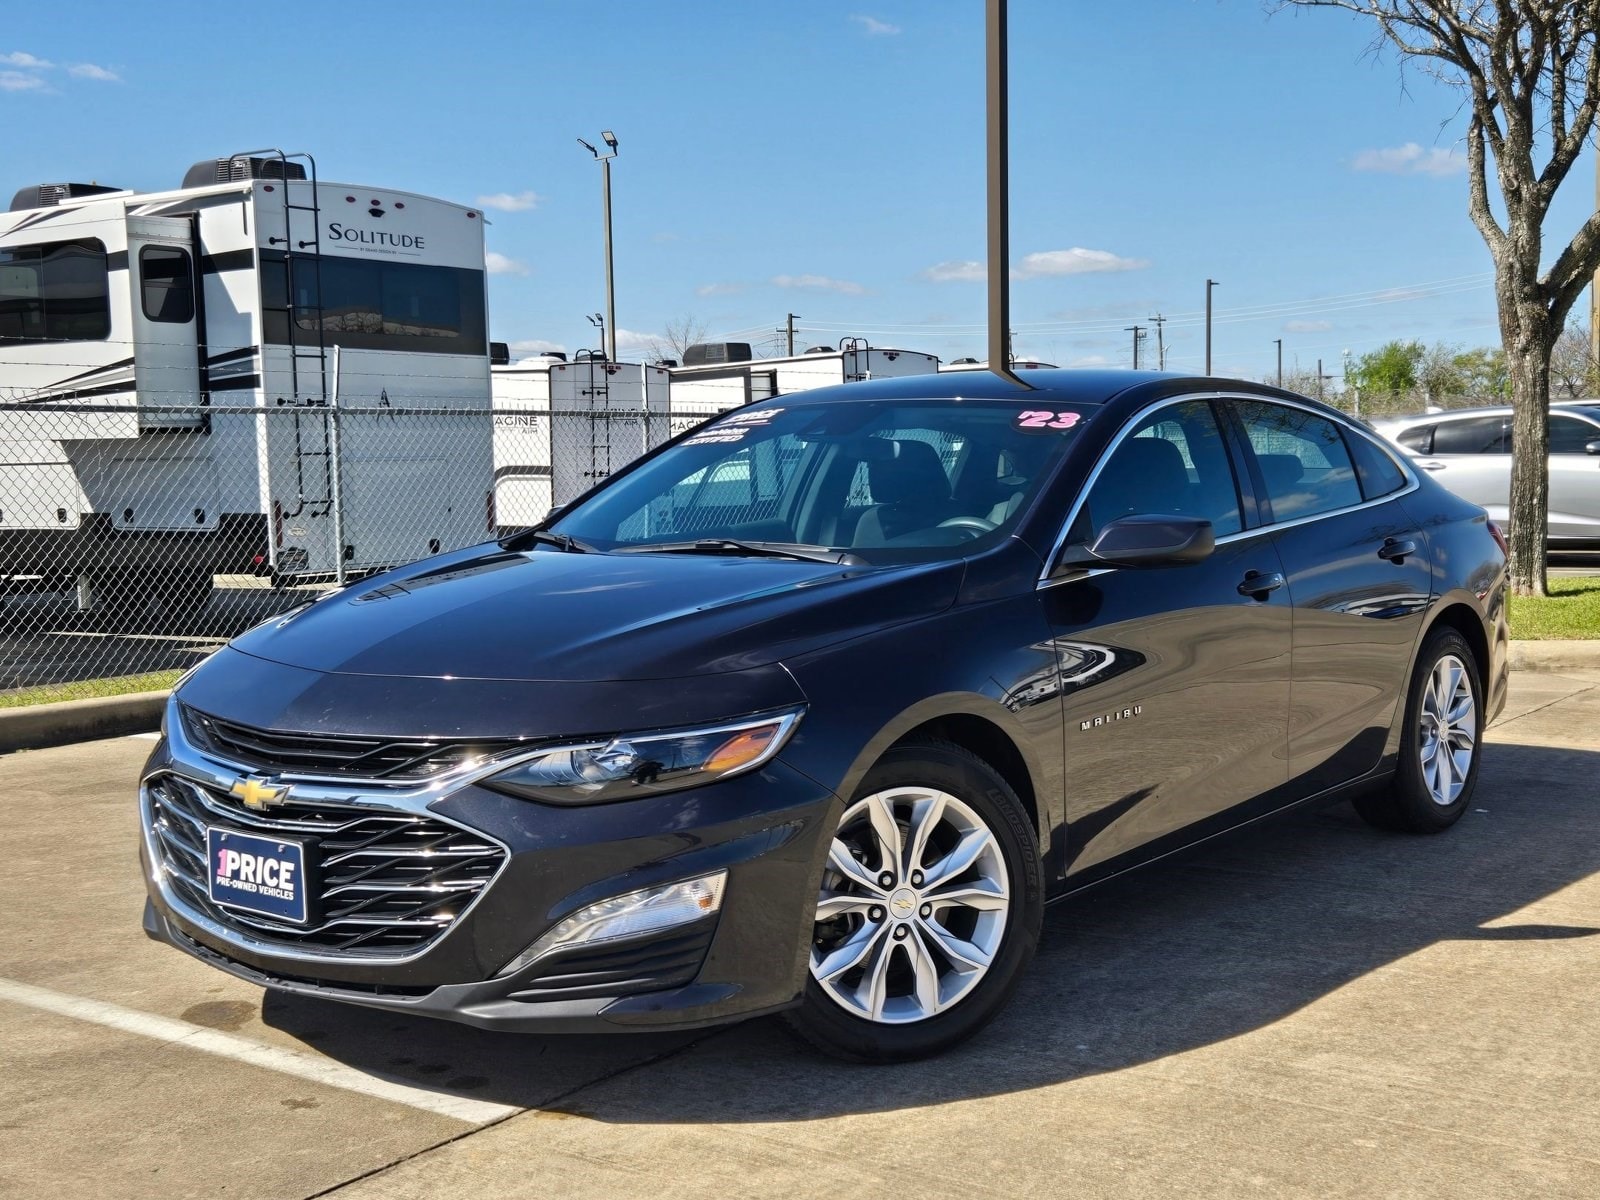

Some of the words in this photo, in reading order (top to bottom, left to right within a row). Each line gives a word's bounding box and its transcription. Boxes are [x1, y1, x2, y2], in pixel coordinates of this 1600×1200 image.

[329, 223, 425, 249] SOLITUDE
[1080, 705, 1142, 731] MALIBU
[216, 876, 258, 893] PRE-OWNED
[259, 885, 295, 901] VEHICLES
